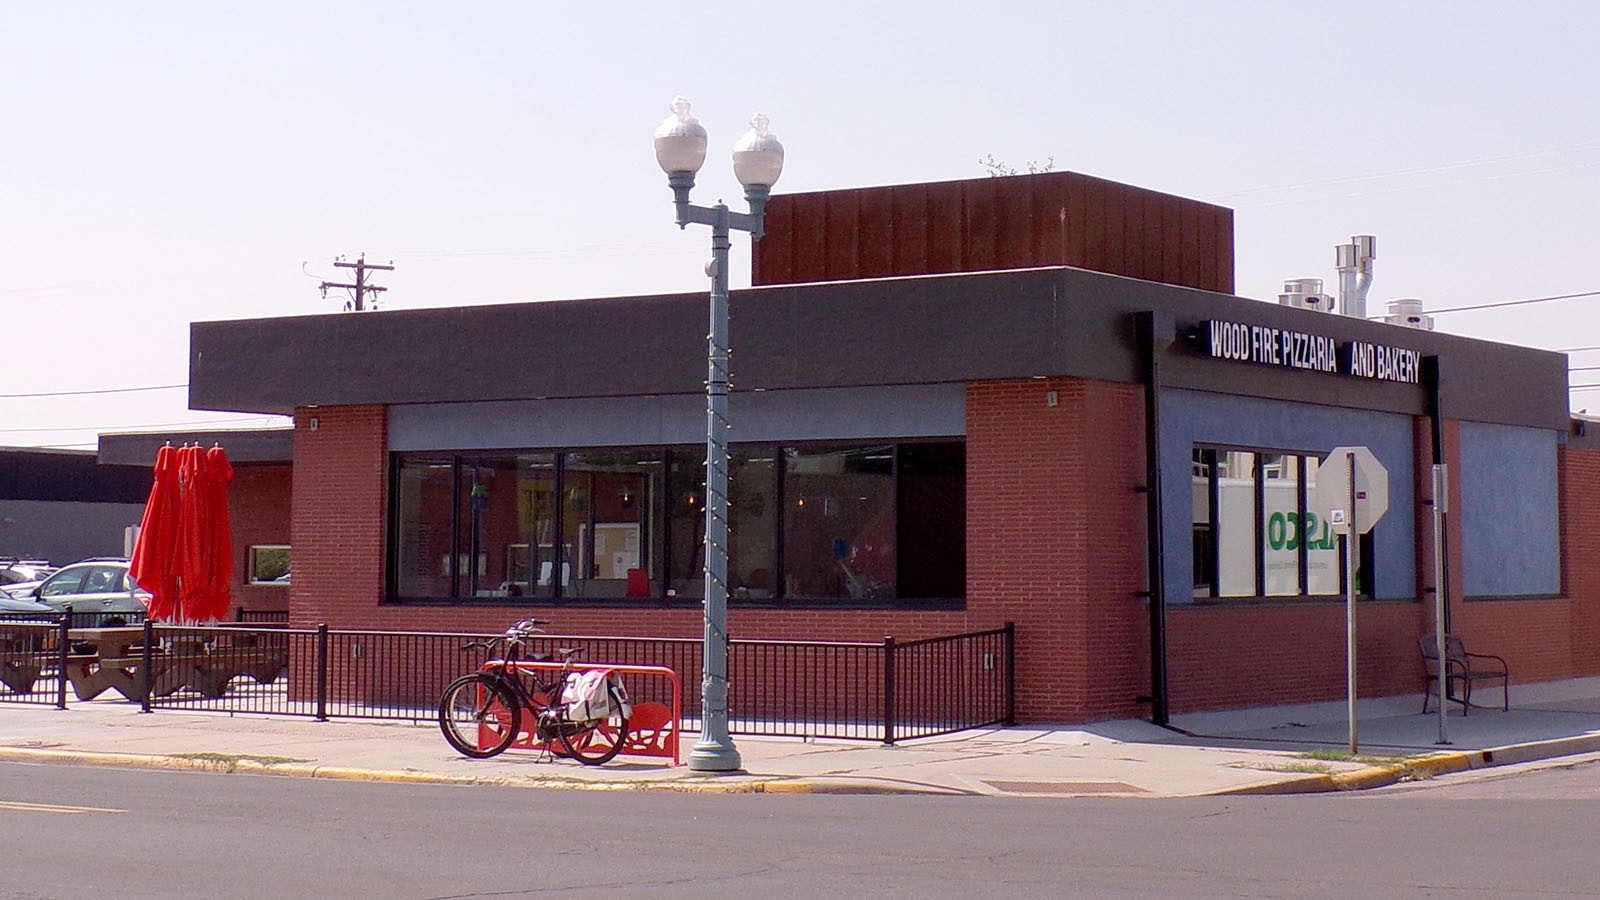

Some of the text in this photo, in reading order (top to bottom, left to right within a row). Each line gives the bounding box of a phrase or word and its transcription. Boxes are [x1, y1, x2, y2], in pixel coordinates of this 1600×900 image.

[1210, 320, 1421, 384] WOOD FIRE PIZZARIA AND BAKERY
